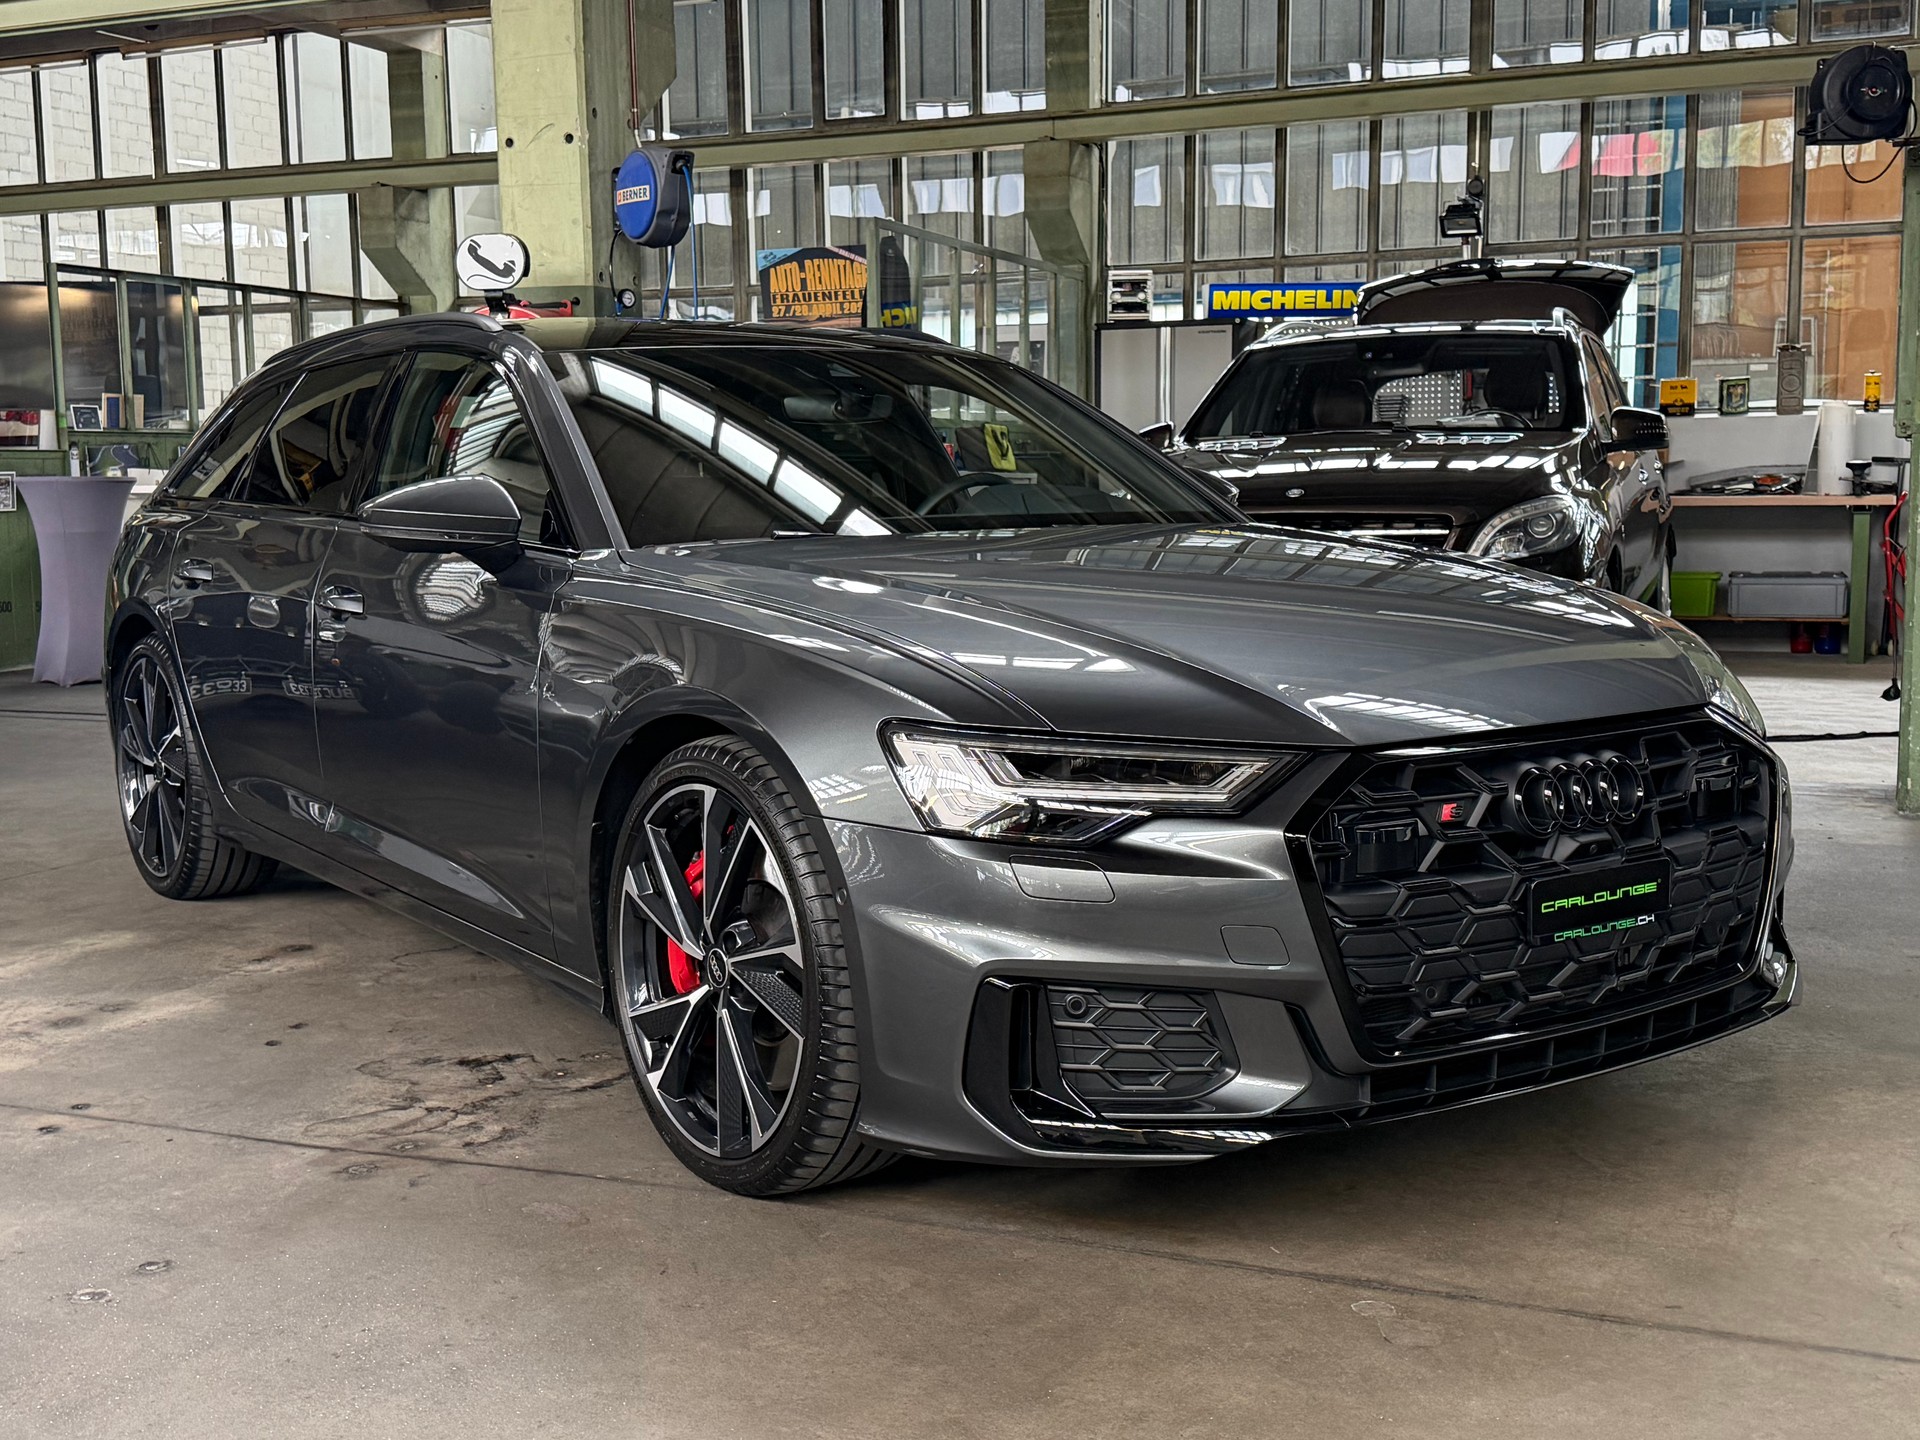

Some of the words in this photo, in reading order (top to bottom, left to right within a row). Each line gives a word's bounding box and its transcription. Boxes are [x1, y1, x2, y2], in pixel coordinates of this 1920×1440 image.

[622, 187, 648, 202] BERNER
[1541, 882, 1658, 914] CARLOUNGE
[1554, 913, 1655, 942] CARLOUNGE.CH
